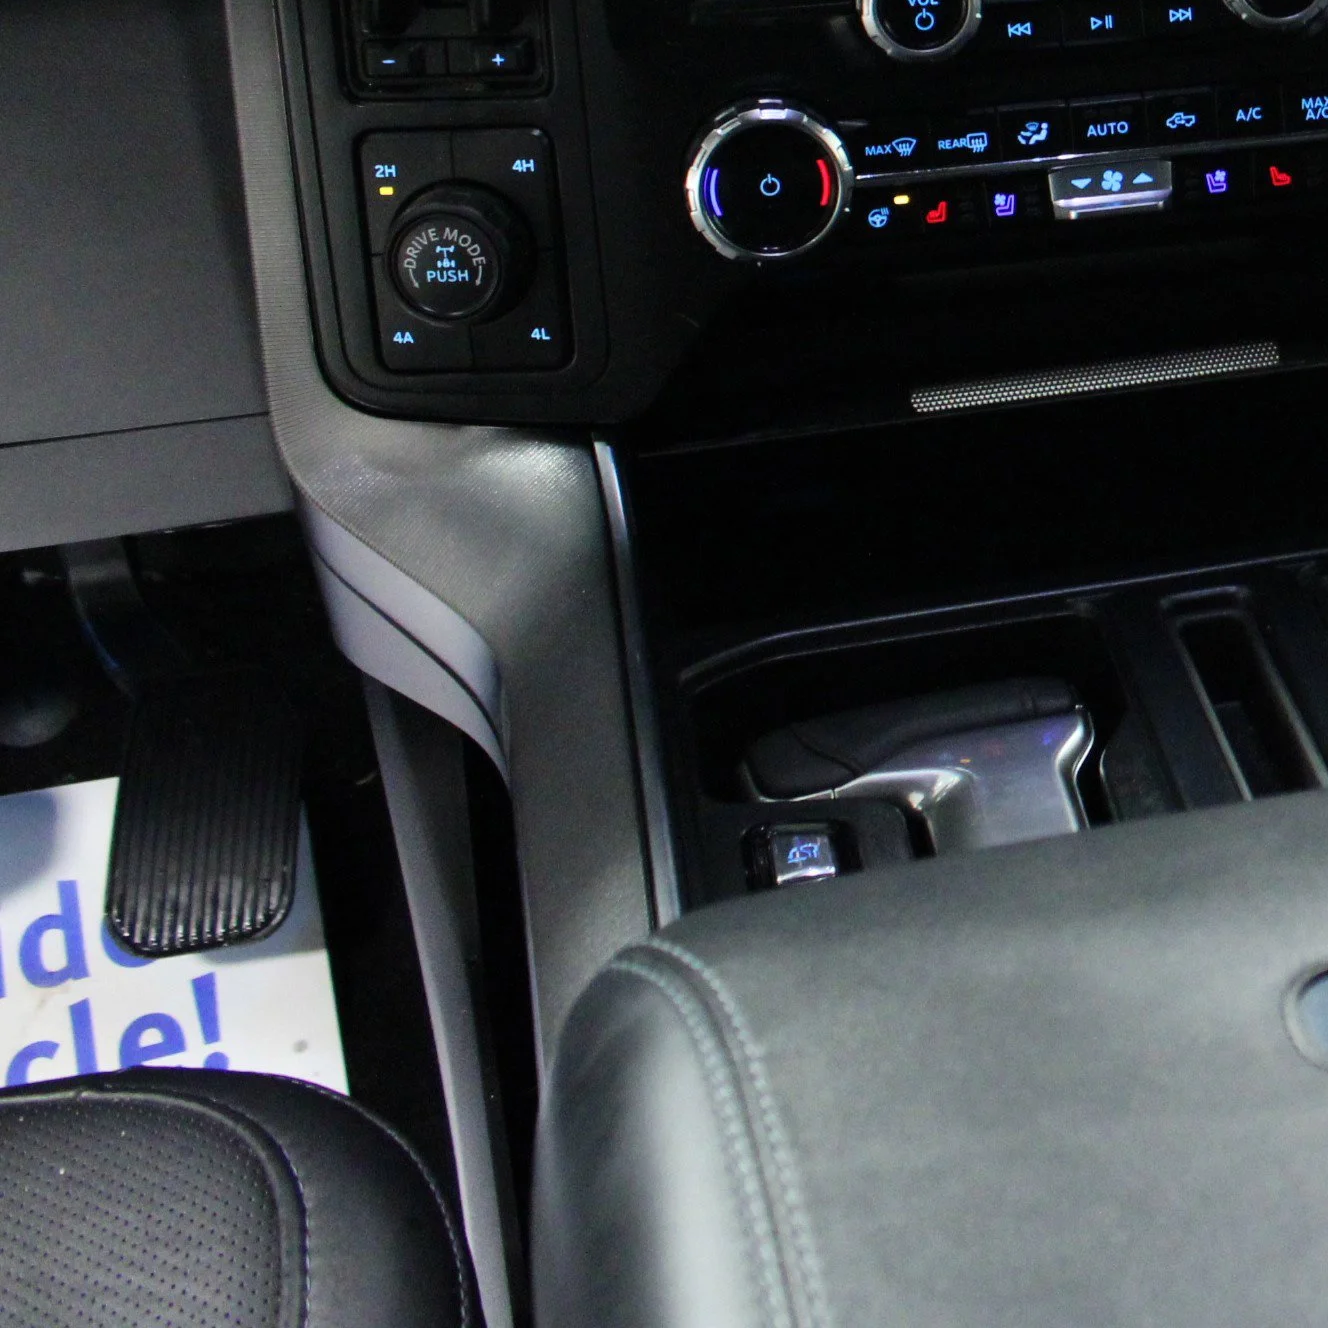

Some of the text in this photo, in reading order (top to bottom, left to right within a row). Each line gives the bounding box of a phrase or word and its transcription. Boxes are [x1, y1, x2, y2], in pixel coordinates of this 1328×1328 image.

[1235, 105, 1263, 122] A/C
[1085, 121, 1130, 138] AUTO
[864, 144, 893, 157] MAX
[937, 137, 968, 151] REAR
[373, 164, 397, 180] 2H
[511, 157, 536, 174] 4H
[403, 226, 487, 271] DRIVE MODE
[426, 268, 470, 284] PUSH
[392, 330, 415, 345] 4A
[530, 326, 552, 342] 4L
